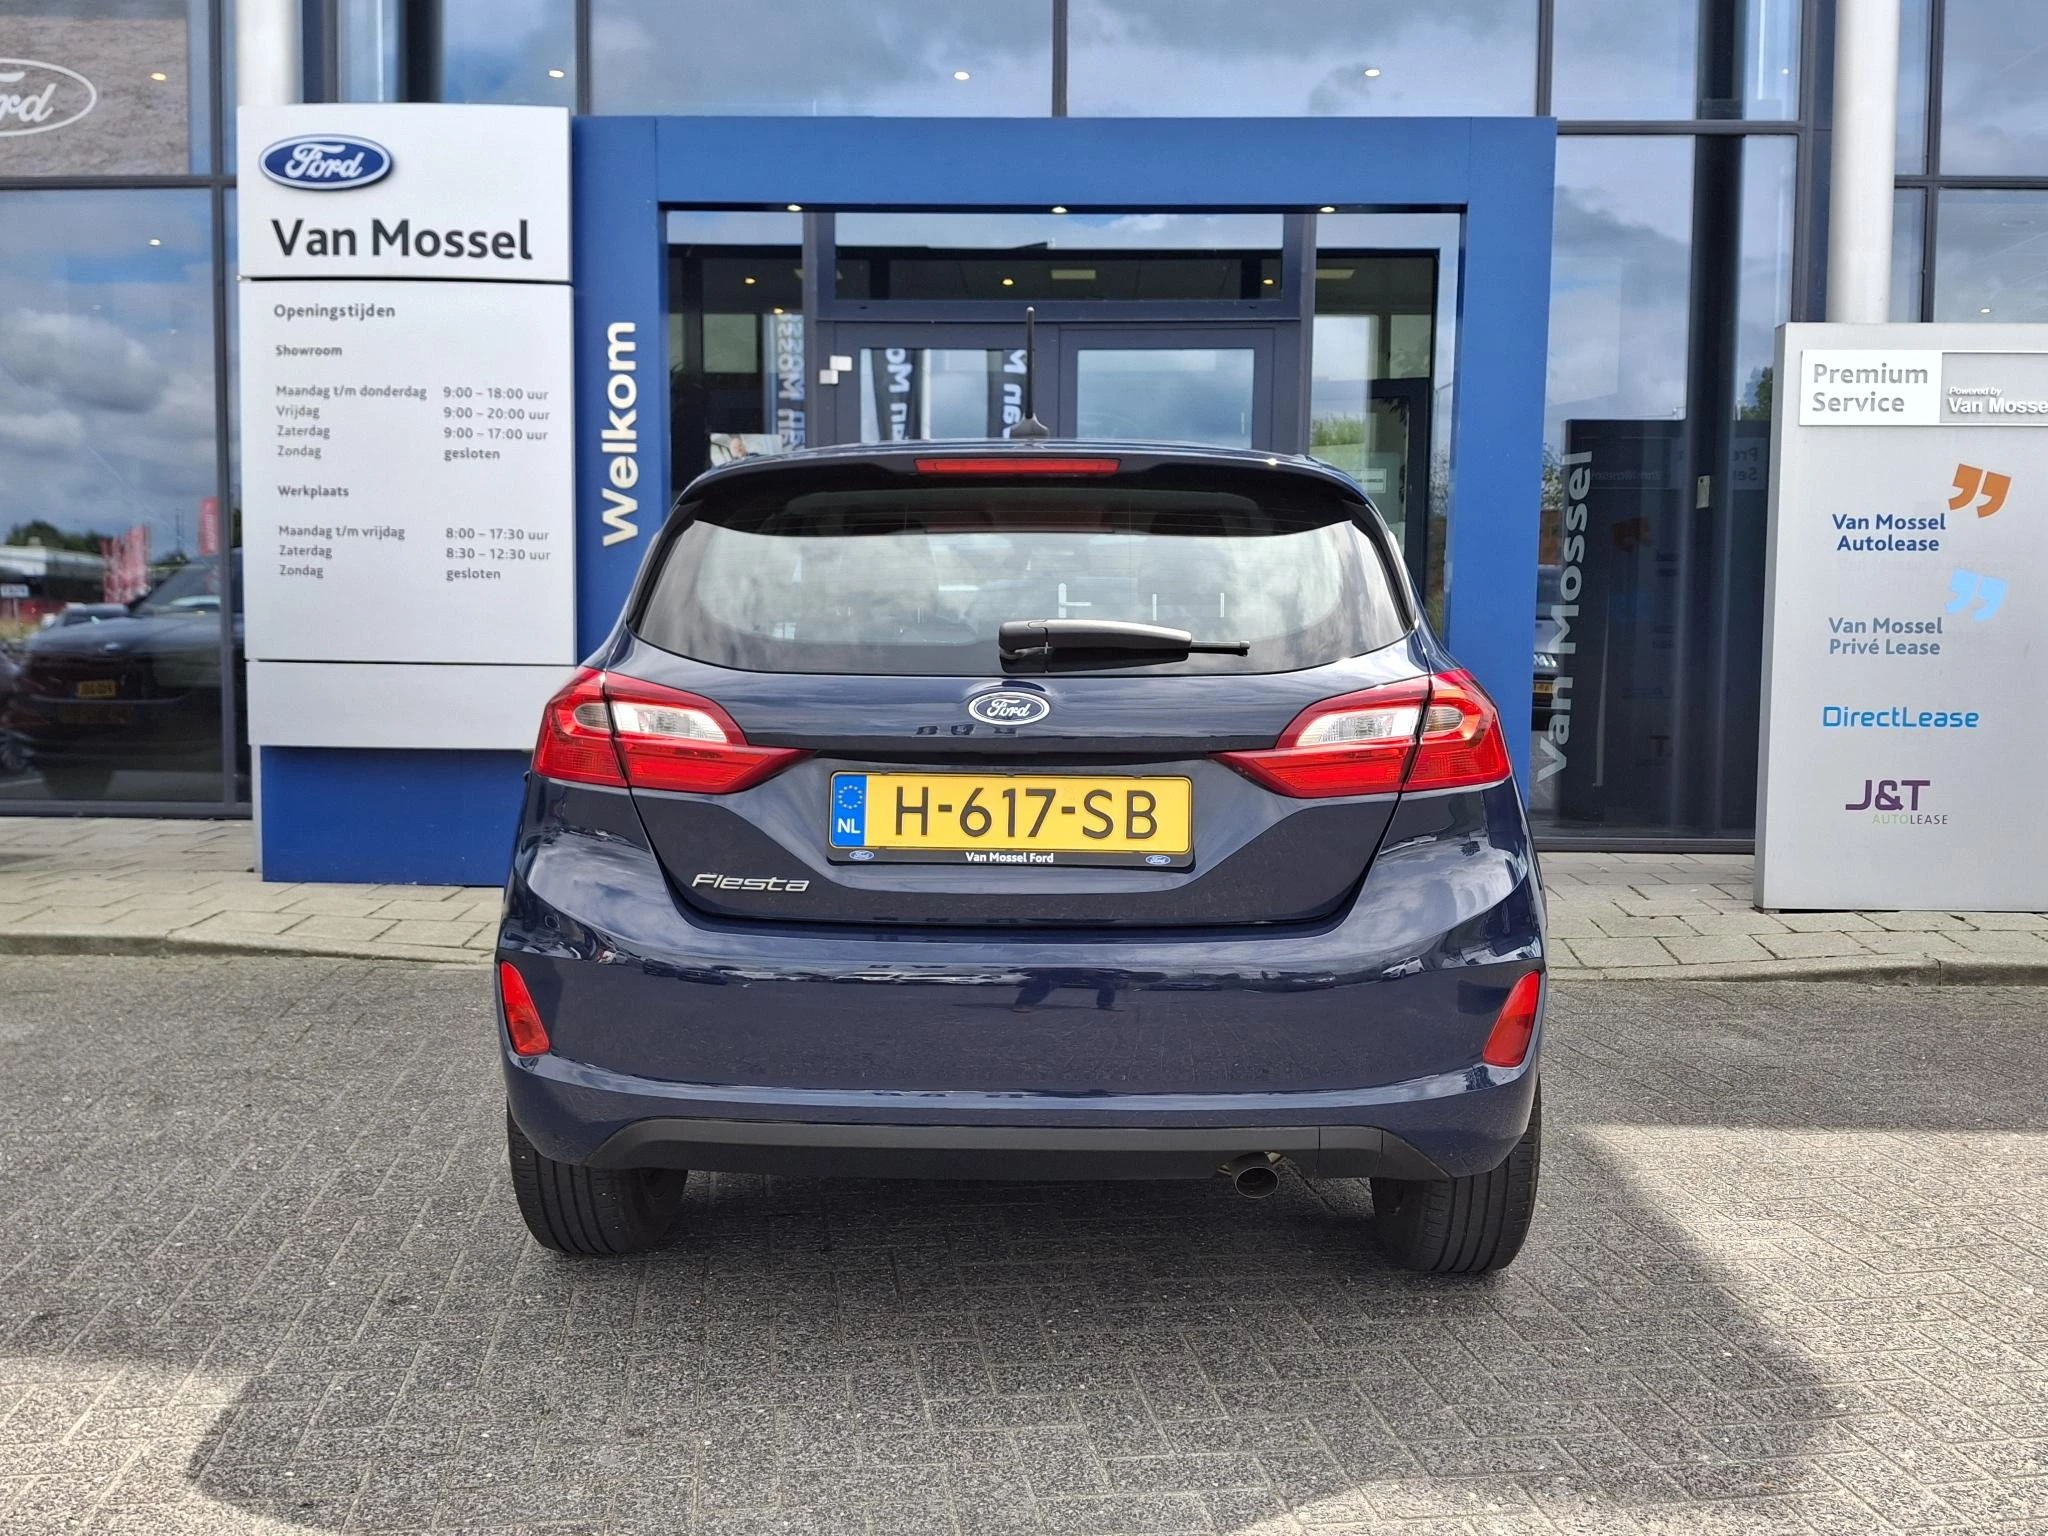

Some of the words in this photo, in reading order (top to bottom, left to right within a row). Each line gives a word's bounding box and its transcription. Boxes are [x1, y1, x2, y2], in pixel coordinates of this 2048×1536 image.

[0, 71, 56, 122] rd
[284, 142, 365, 179] Ford
[271, 218, 357, 257] Van
[371, 218, 533, 260] Mossel
[273, 303, 396, 322] Openingstijden
[275, 345, 343, 357] Showroom
[1812, 362, 1928, 384] Premium
[276, 385, 331, 400] Maandag
[333, 385, 357, 398] t/m
[359, 385, 428, 401] donderdag
[443, 387, 473, 399] 9:00
[487, 387, 524, 400] 18:00
[527, 390, 549, 400] uur
[1949, 386, 1989, 396] Powered
[1990, 386, 2002, 398] by
[1811, 391, 1905, 413] Service
[1948, 397, 1983, 414] Van
[276, 405, 321, 420] Vrijdag
[443, 407, 473, 419] 9:00
[487, 408, 525, 420] 20:00
[528, 410, 551, 421] uur
[276, 425, 331, 440] Zaterdag
[443, 427, 473, 439] 9:00
[488, 428, 523, 441] 17:00
[526, 430, 548, 440] uur
[601, 321, 639, 547] Welkom
[277, 445, 322, 460] Zondag
[443, 448, 501, 462] gesloten
[277, 485, 350, 499] Werkplaats
[1832, 513, 1869, 530] Van
[1875, 512, 1946, 531] Mossel
[278, 525, 333, 540] Maandag
[335, 525, 359, 538] t/m
[362, 526, 406, 541] vrijdag
[446, 527, 475, 540] 8:00
[489, 528, 524, 541] 17:30
[528, 530, 549, 541] uur
[1836, 534, 1940, 552] Autolease
[279, 544, 333, 560] Zaterdag
[446, 548, 475, 560] 8:30
[490, 548, 526, 561] 12:30
[529, 551, 551, 561] uur
[1547, 451, 1593, 655] Mossel
[279, 564, 324, 579] Zondag
[446, 567, 501, 582] gesloten
[1828, 616, 1866, 634] Van
[1872, 616, 1943, 634] Mossel
[1829, 638, 1880, 655] Privé
[1885, 638, 1941, 655] Lease
[986, 697, 1031, 719] Ford
[1822, 706, 1980, 728] DirectLease
[1537, 675, 1574, 783] Van
[1845, 779, 1931, 811] J&T
[894, 786, 1159, 841] H-617-SB
[1871, 814, 1949, 825] AUTOLEASE
[837, 818, 861, 835] NL
[966, 851, 989, 862] Van
[990, 851, 1028, 863] Mossel
[1029, 852, 1054, 864] Ford
[691, 871, 810, 893] Fiesta
